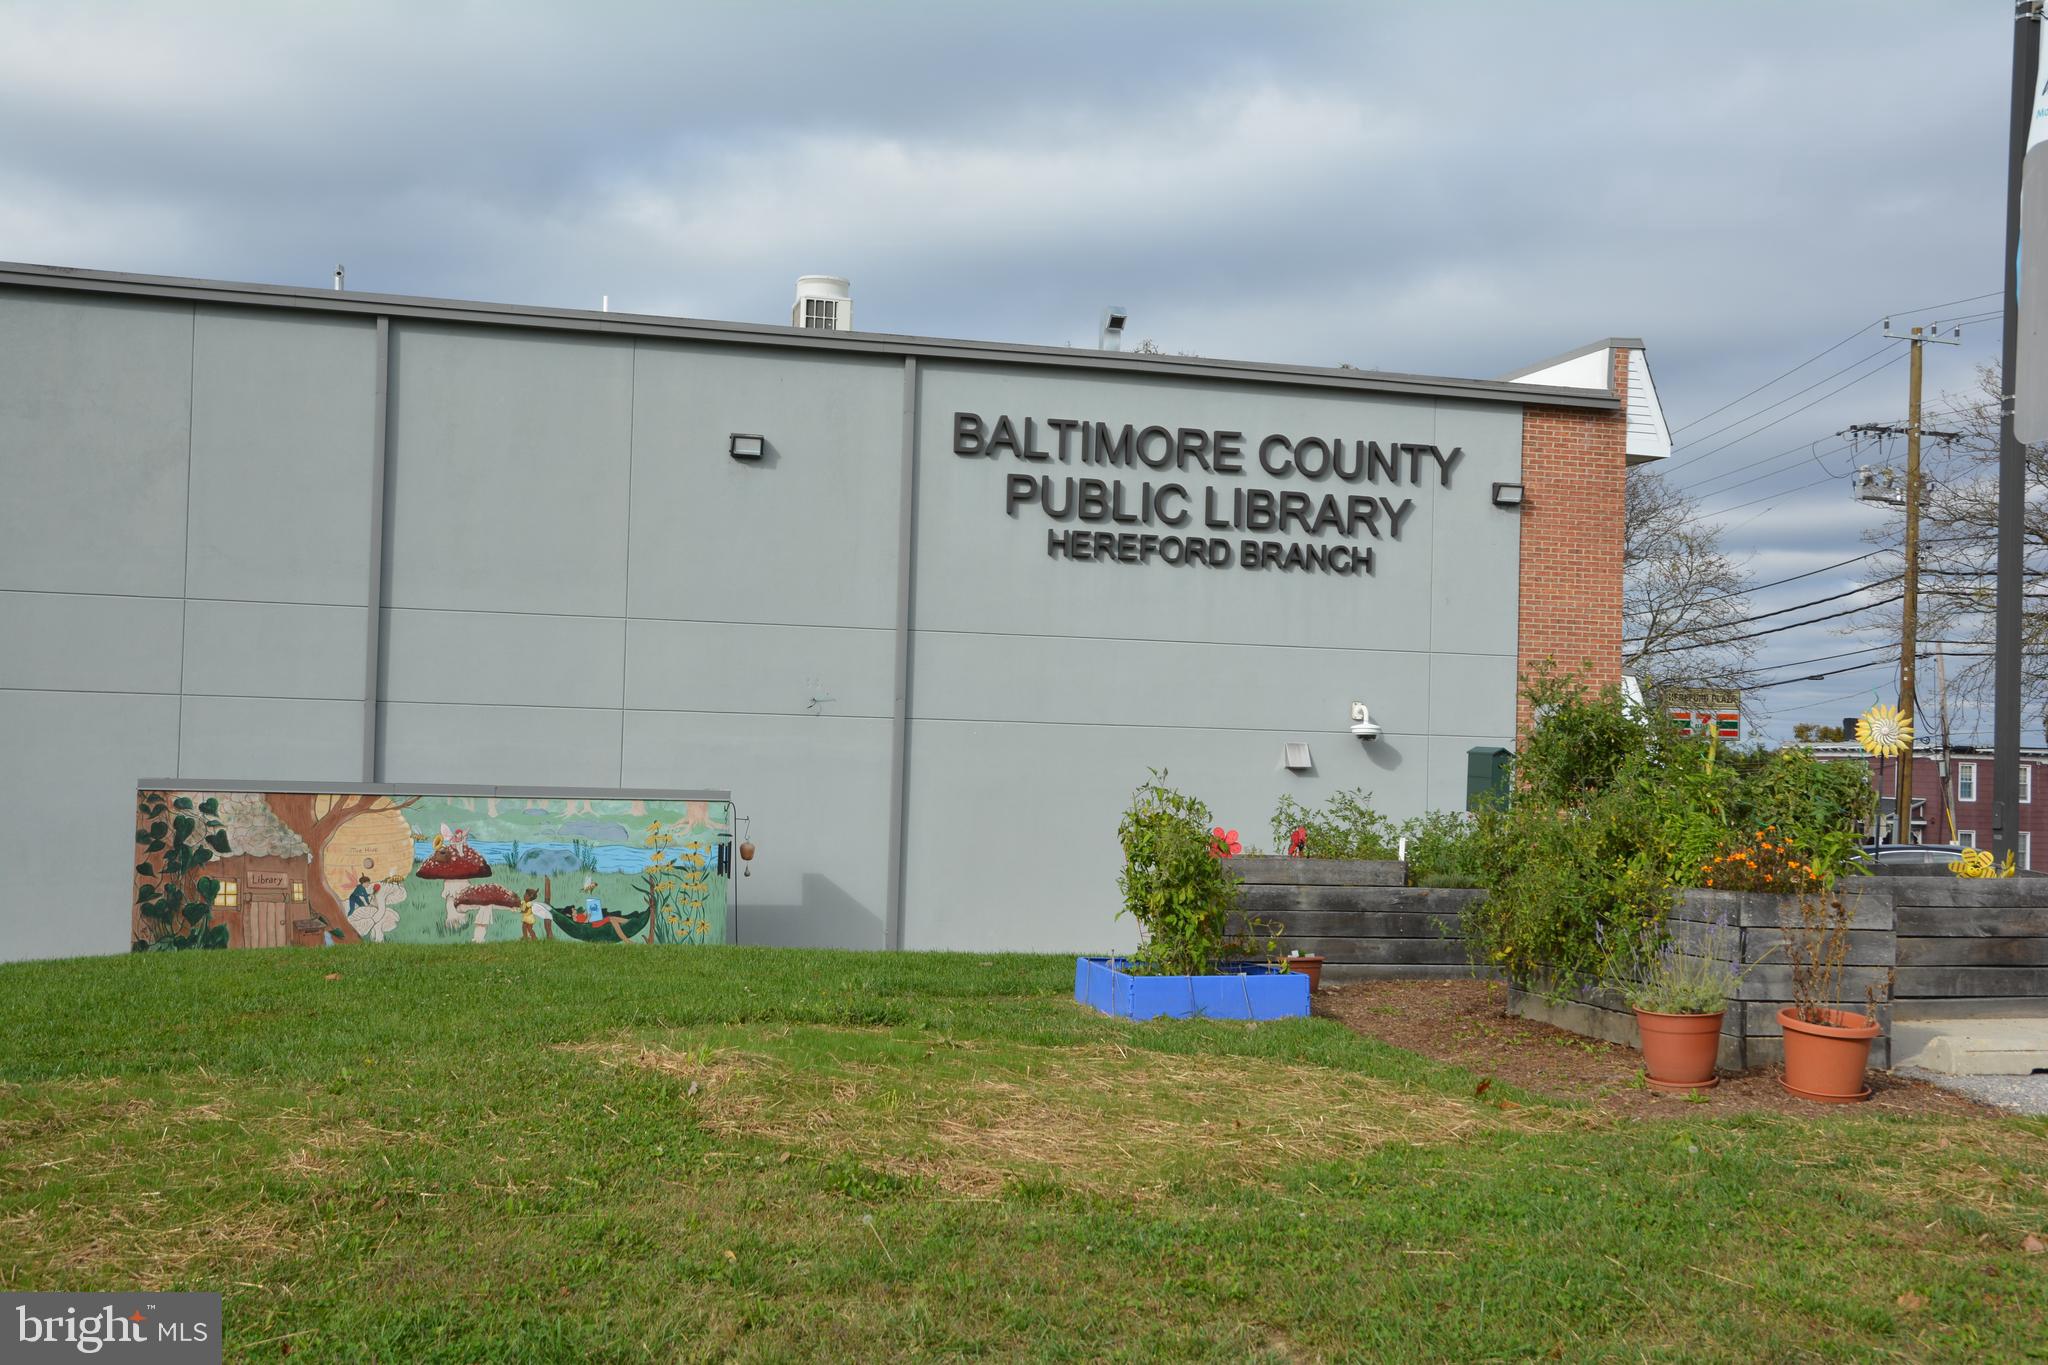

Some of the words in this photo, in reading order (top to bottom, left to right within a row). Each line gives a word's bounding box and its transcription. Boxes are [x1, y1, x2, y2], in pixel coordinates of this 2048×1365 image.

[953, 412, 1243, 474] BALTIMORE
[1258, 434, 1462, 487] COUNTY
[1006, 473, 1189, 527] PUBLIC
[1204, 485, 1412, 538] LIBRARY
[1047, 528, 1232, 568] HEREFORD
[1240, 540, 1373, 575] BRANCH
[252, 873, 283, 886] Library
